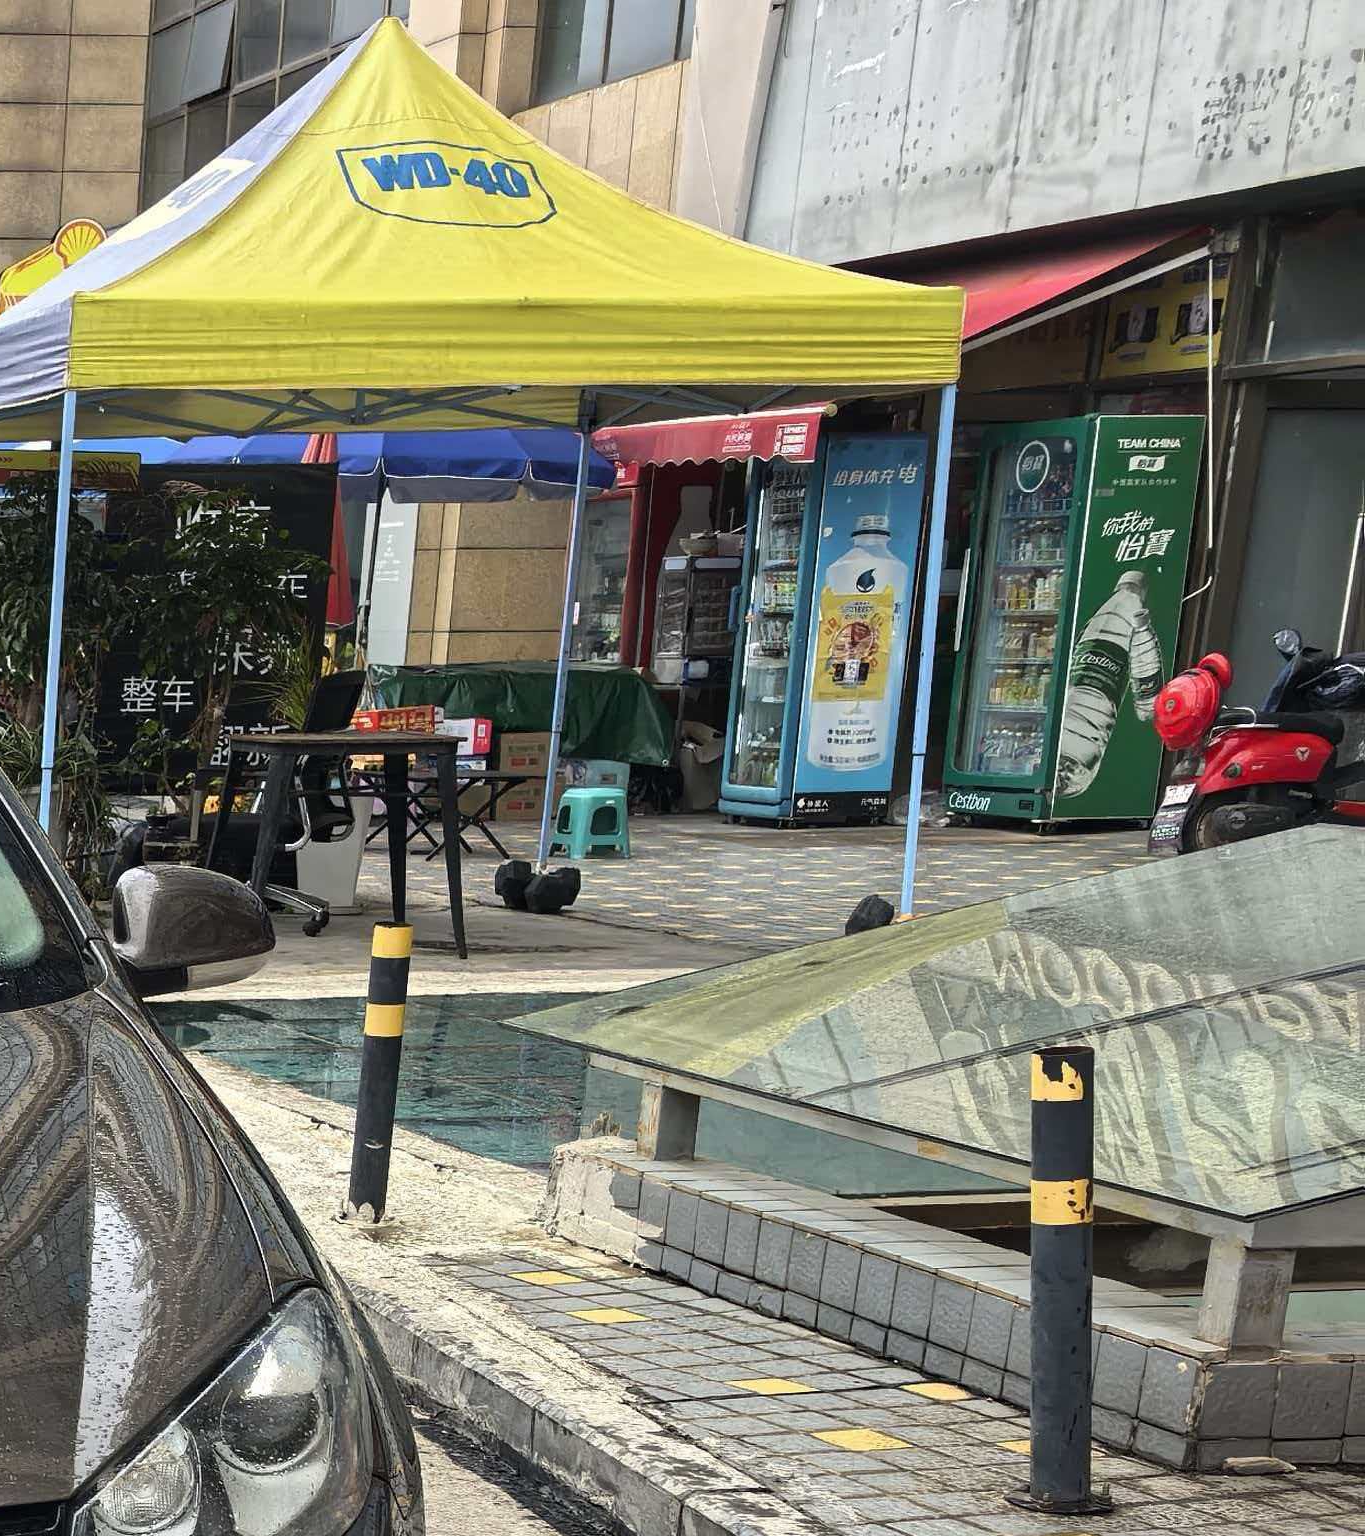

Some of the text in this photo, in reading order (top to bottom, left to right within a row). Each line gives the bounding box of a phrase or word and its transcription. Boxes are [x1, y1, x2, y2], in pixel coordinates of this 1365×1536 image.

[361, 152, 531, 199] WD-40
[1118, 437, 1181, 449] TEAM CHINA
[1101, 509, 1155, 538] 你我的
[120, 675, 194, 713] 整车
